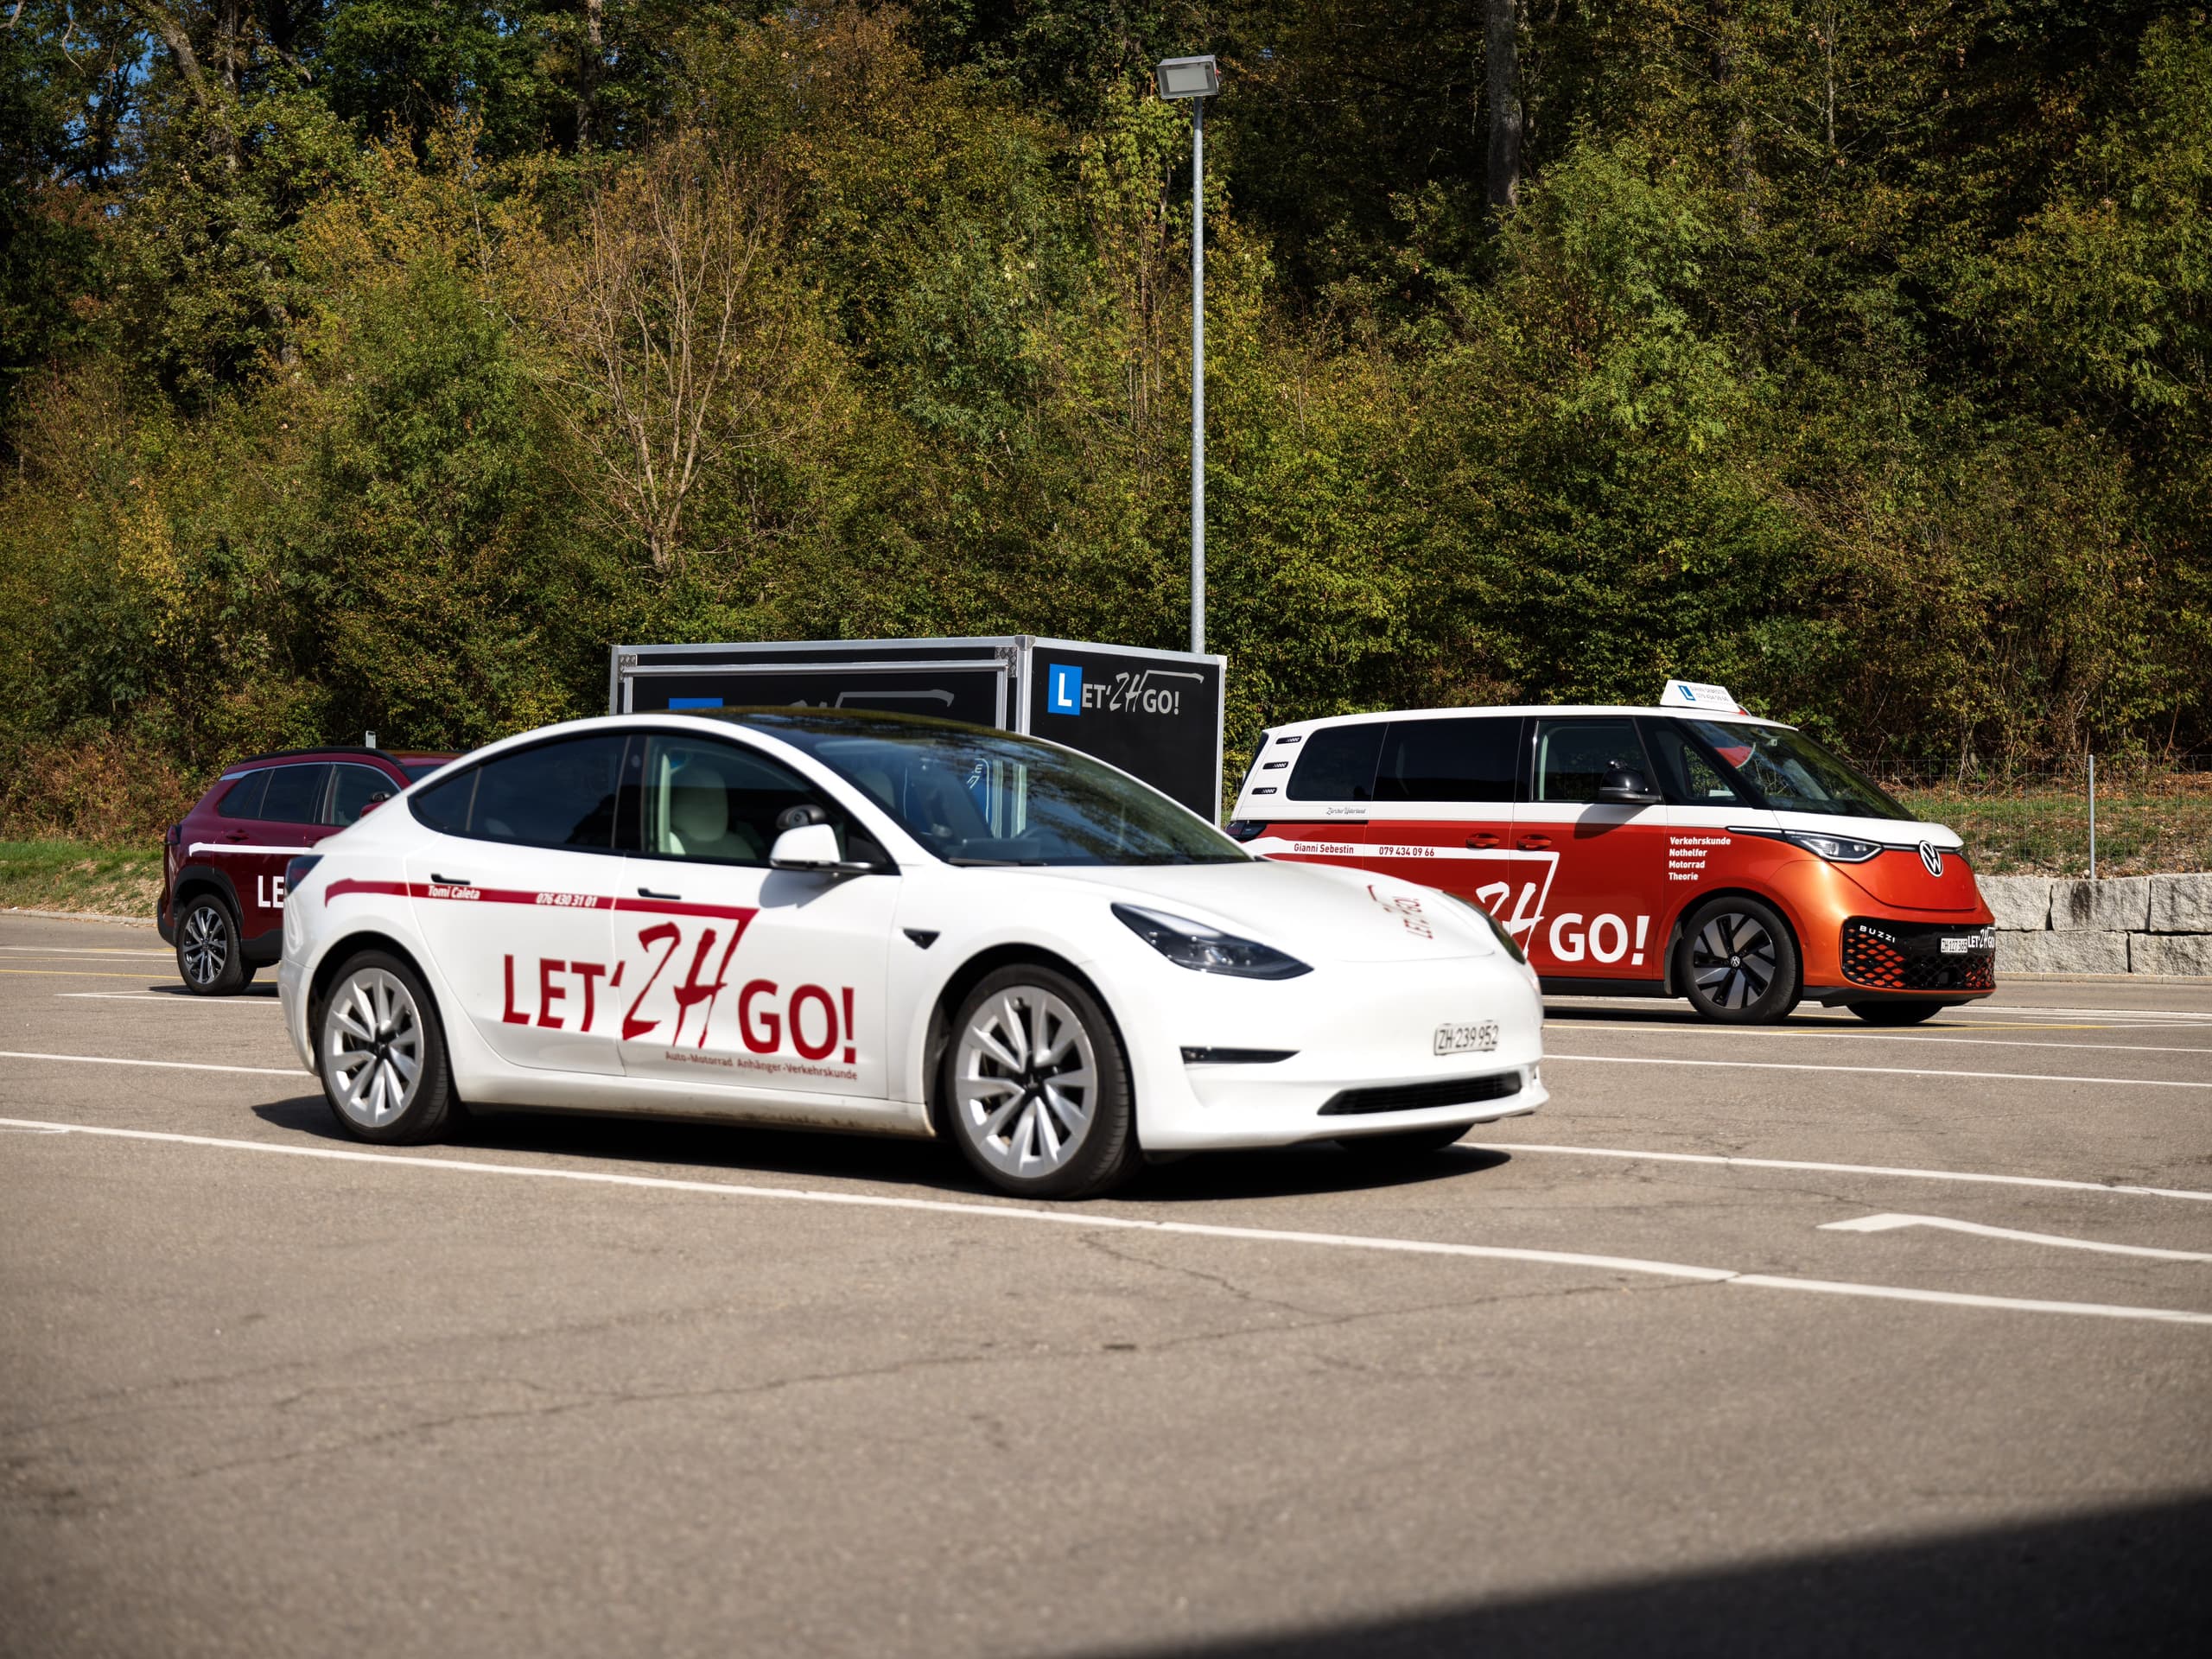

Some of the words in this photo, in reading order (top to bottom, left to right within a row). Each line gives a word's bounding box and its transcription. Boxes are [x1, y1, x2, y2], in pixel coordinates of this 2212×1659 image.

[1143, 689, 1179, 715] GO!
[1294, 842, 1319, 853] Gianni
[1319, 843, 1354, 854] Sebestin
[1379, 846, 1393, 855] 079
[1395, 847, 1410, 856] 434
[1412, 847, 1422, 856] 09
[1425, 847, 1434, 856] 66
[1669, 836, 1732, 845] Verkehrskunde
[1669, 860, 1706, 868] Motorrad
[1669, 872, 1699, 880] Theorie
[428, 885, 449, 898] Tomi
[451, 887, 480, 899] Caleta
[536, 893, 554, 905] 076
[555, 893, 571, 906] 430
[572, 894, 583, 906] 31
[585, 895, 598, 907] 01
[1549, 912, 1650, 965] GO!
[1859, 925, 1896, 944] BUZZI
[738, 979, 857, 1064] GO!
